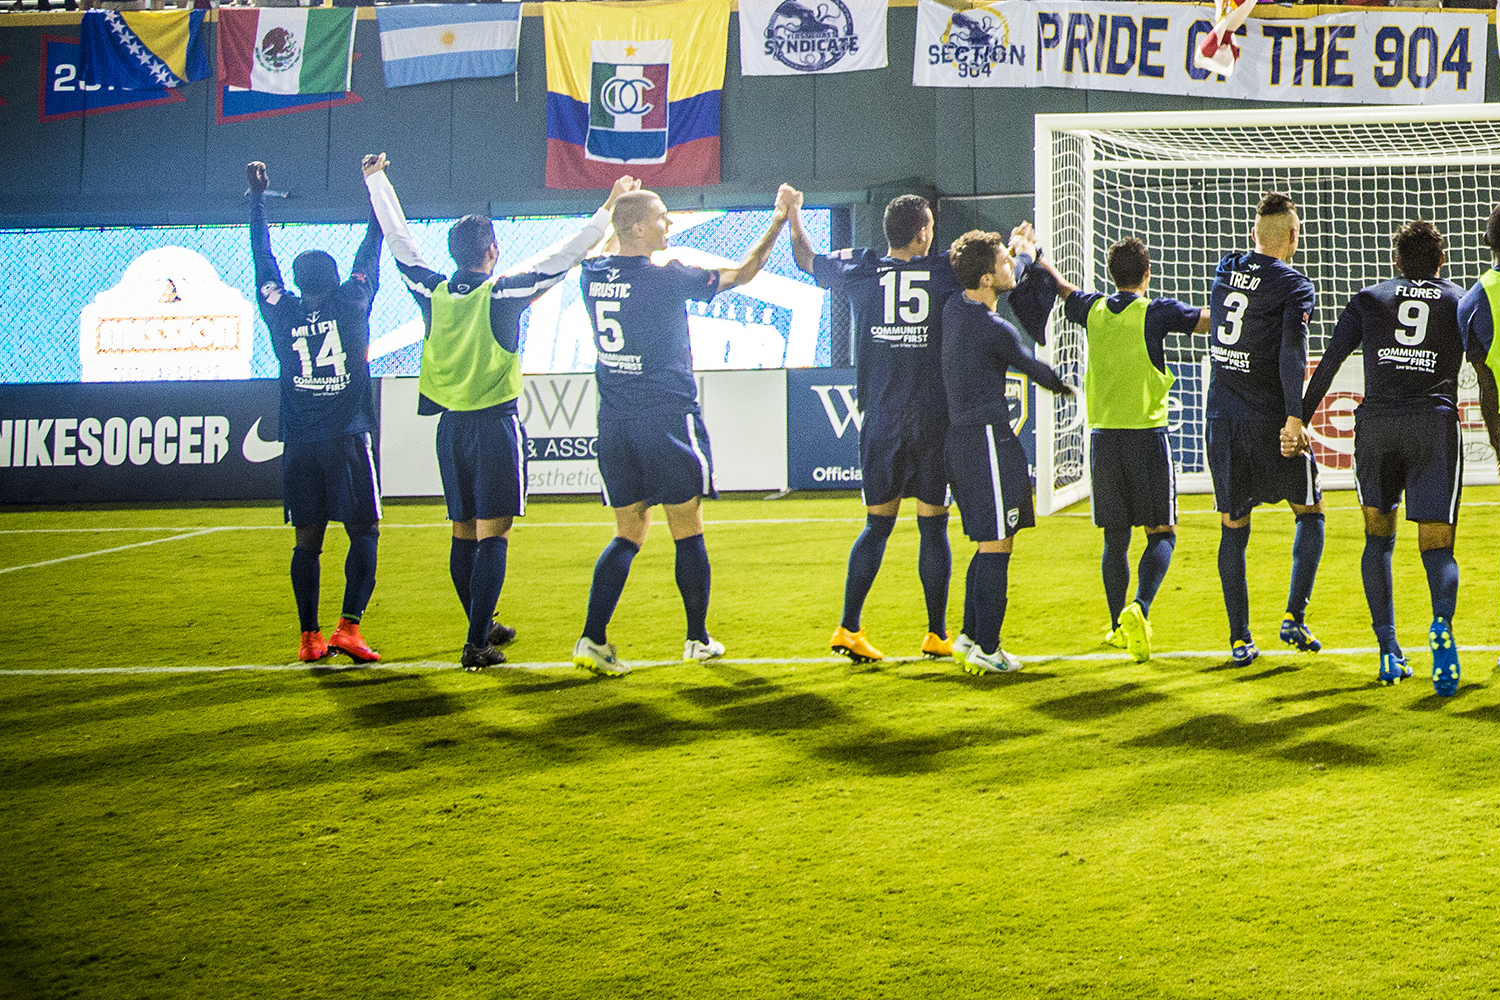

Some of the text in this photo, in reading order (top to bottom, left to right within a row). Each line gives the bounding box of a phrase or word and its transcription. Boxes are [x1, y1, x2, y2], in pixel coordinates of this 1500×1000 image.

[764, 36, 859, 55] SYNDICATE
[928, 43, 1026, 66] SECTION
[1037, 11, 1169, 79] PRIDE
[1263, 25, 1356, 88] THE
[1373, 25, 1473, 91] 904
[958, 61, 992, 78] 904
[589, 281, 632, 298] HRUSTIC
[1229, 270, 1261, 291] TREJO
[879, 270, 930, 324] 15
[1395, 285, 1442, 300] FLORES
[595, 300, 625, 352] 5
[1217, 291, 1249, 345] 3
[1394, 300, 1430, 346] 9
[870, 326, 929, 335] COMMUNITY
[903, 334, 929, 343] FIRST
[292, 330, 347, 378] 14
[1377, 347, 1438, 360] COMMUNITY
[1409, 357, 1437, 368] FIRST
[293, 373, 351, 385] COMMUNITY
